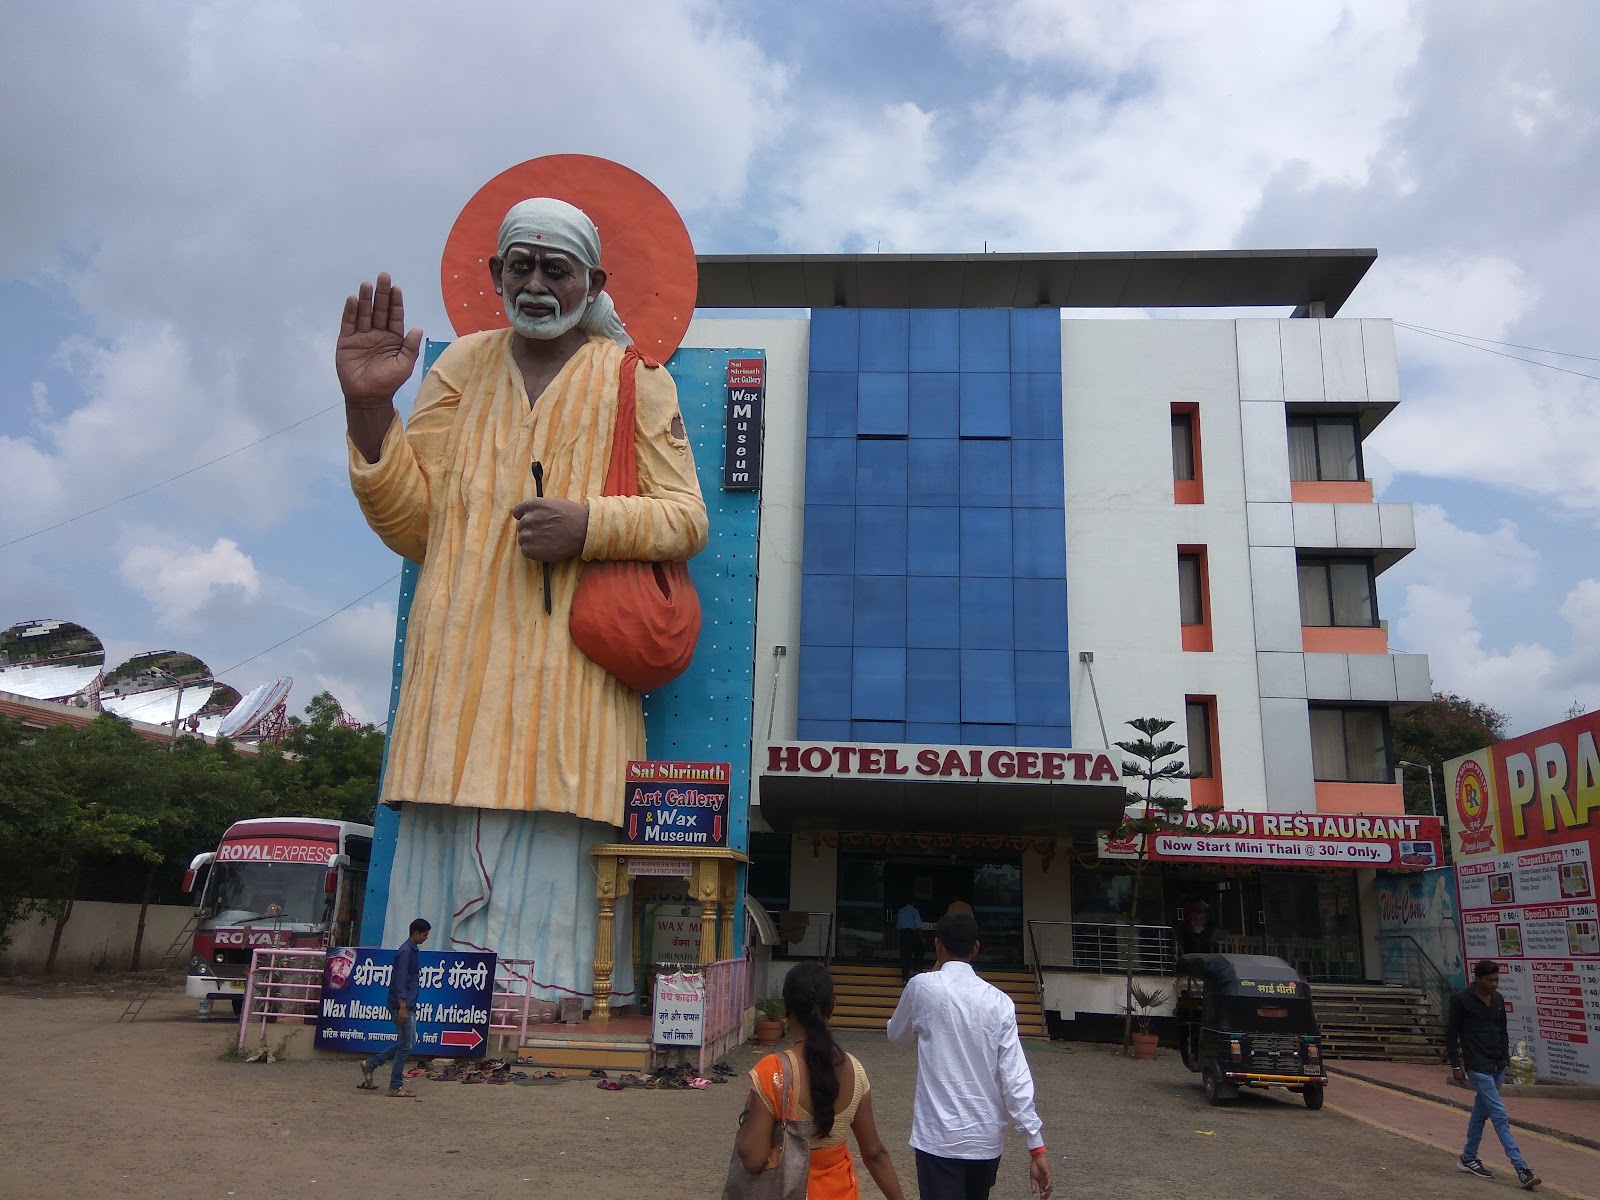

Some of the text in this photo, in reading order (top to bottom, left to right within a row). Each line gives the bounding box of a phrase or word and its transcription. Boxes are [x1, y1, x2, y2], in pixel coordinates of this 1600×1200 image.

[730, 376, 761, 385] Art Gallery
[731, 389, 758, 402] Wax
[732, 404, 752, 482] Museum
[630, 763, 726, 781] Sai Shrinath
[767, 746, 1119, 781] HOTEL SAI GEETA
[1505, 731, 1600, 837] PRA
[631, 788, 725, 811] Art Gallery
[646, 808, 698, 828] & Wax
[644, 825, 708, 843] Museum
[1264, 816, 1420, 840] RESTAURANT
[220, 844, 334, 862] ROYAL EXPRESS
[1162, 839, 1381, 860] Now Start Mini Thali @ 30/- Only.
[1518, 856, 1544, 868] Chapati
[1545, 852, 1562, 863] Plate
[1571, 848, 1584, 857] 70/-
[1460, 866, 1474, 876] Mini
[1475, 862, 1494, 874] Thali
[1466, 914, 1480, 923] Rice
[1481, 912, 1500, 922] Plate
[1525, 909, 1548, 920] Special
[1548, 908, 1568, 918] Thali
[1576, 906, 1594, 916] 100/-
[658, 921, 684, 932] WAX
[214, 932, 286, 945] ROYAL
[353, 957, 394, 987] श्रीना
[448, 960, 488, 991] गॅलरी
[1588, 976, 1600, 984] 30/
[1257, 984, 1276, 995] साई
[1589, 989, 1600, 997] 40/
[322, 998, 346, 1018] Wax
[434, 1004, 488, 1025] Articales
